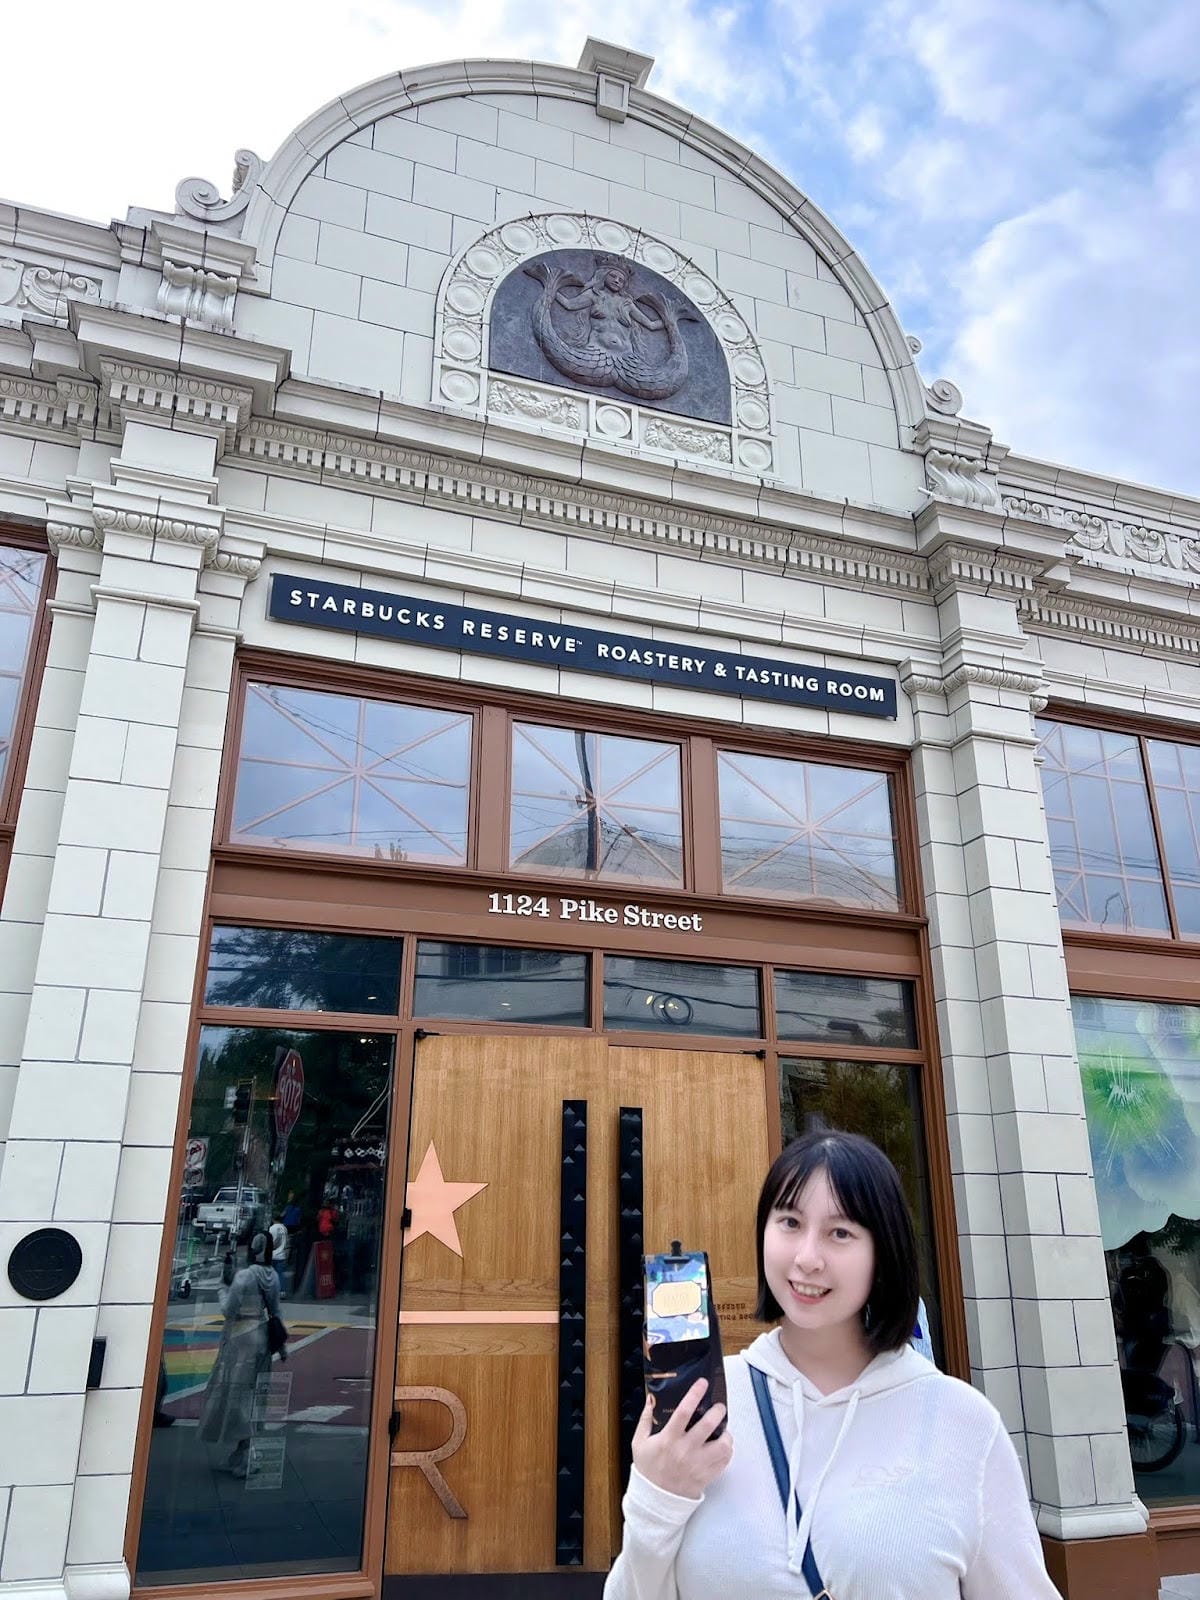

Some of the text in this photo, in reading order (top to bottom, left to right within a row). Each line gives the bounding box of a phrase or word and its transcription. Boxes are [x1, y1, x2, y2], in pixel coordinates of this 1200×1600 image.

[290, 589, 445, 630] STARBUCKS
[597, 643, 706, 673] ROASTERY
[713, 663, 728, 678] &
[735, 665, 819, 692] TASTING
[827, 681, 885, 702] ROOM
[488, 892, 703, 932] 1124 Pike Street
[391, 1385, 468, 1520] R
